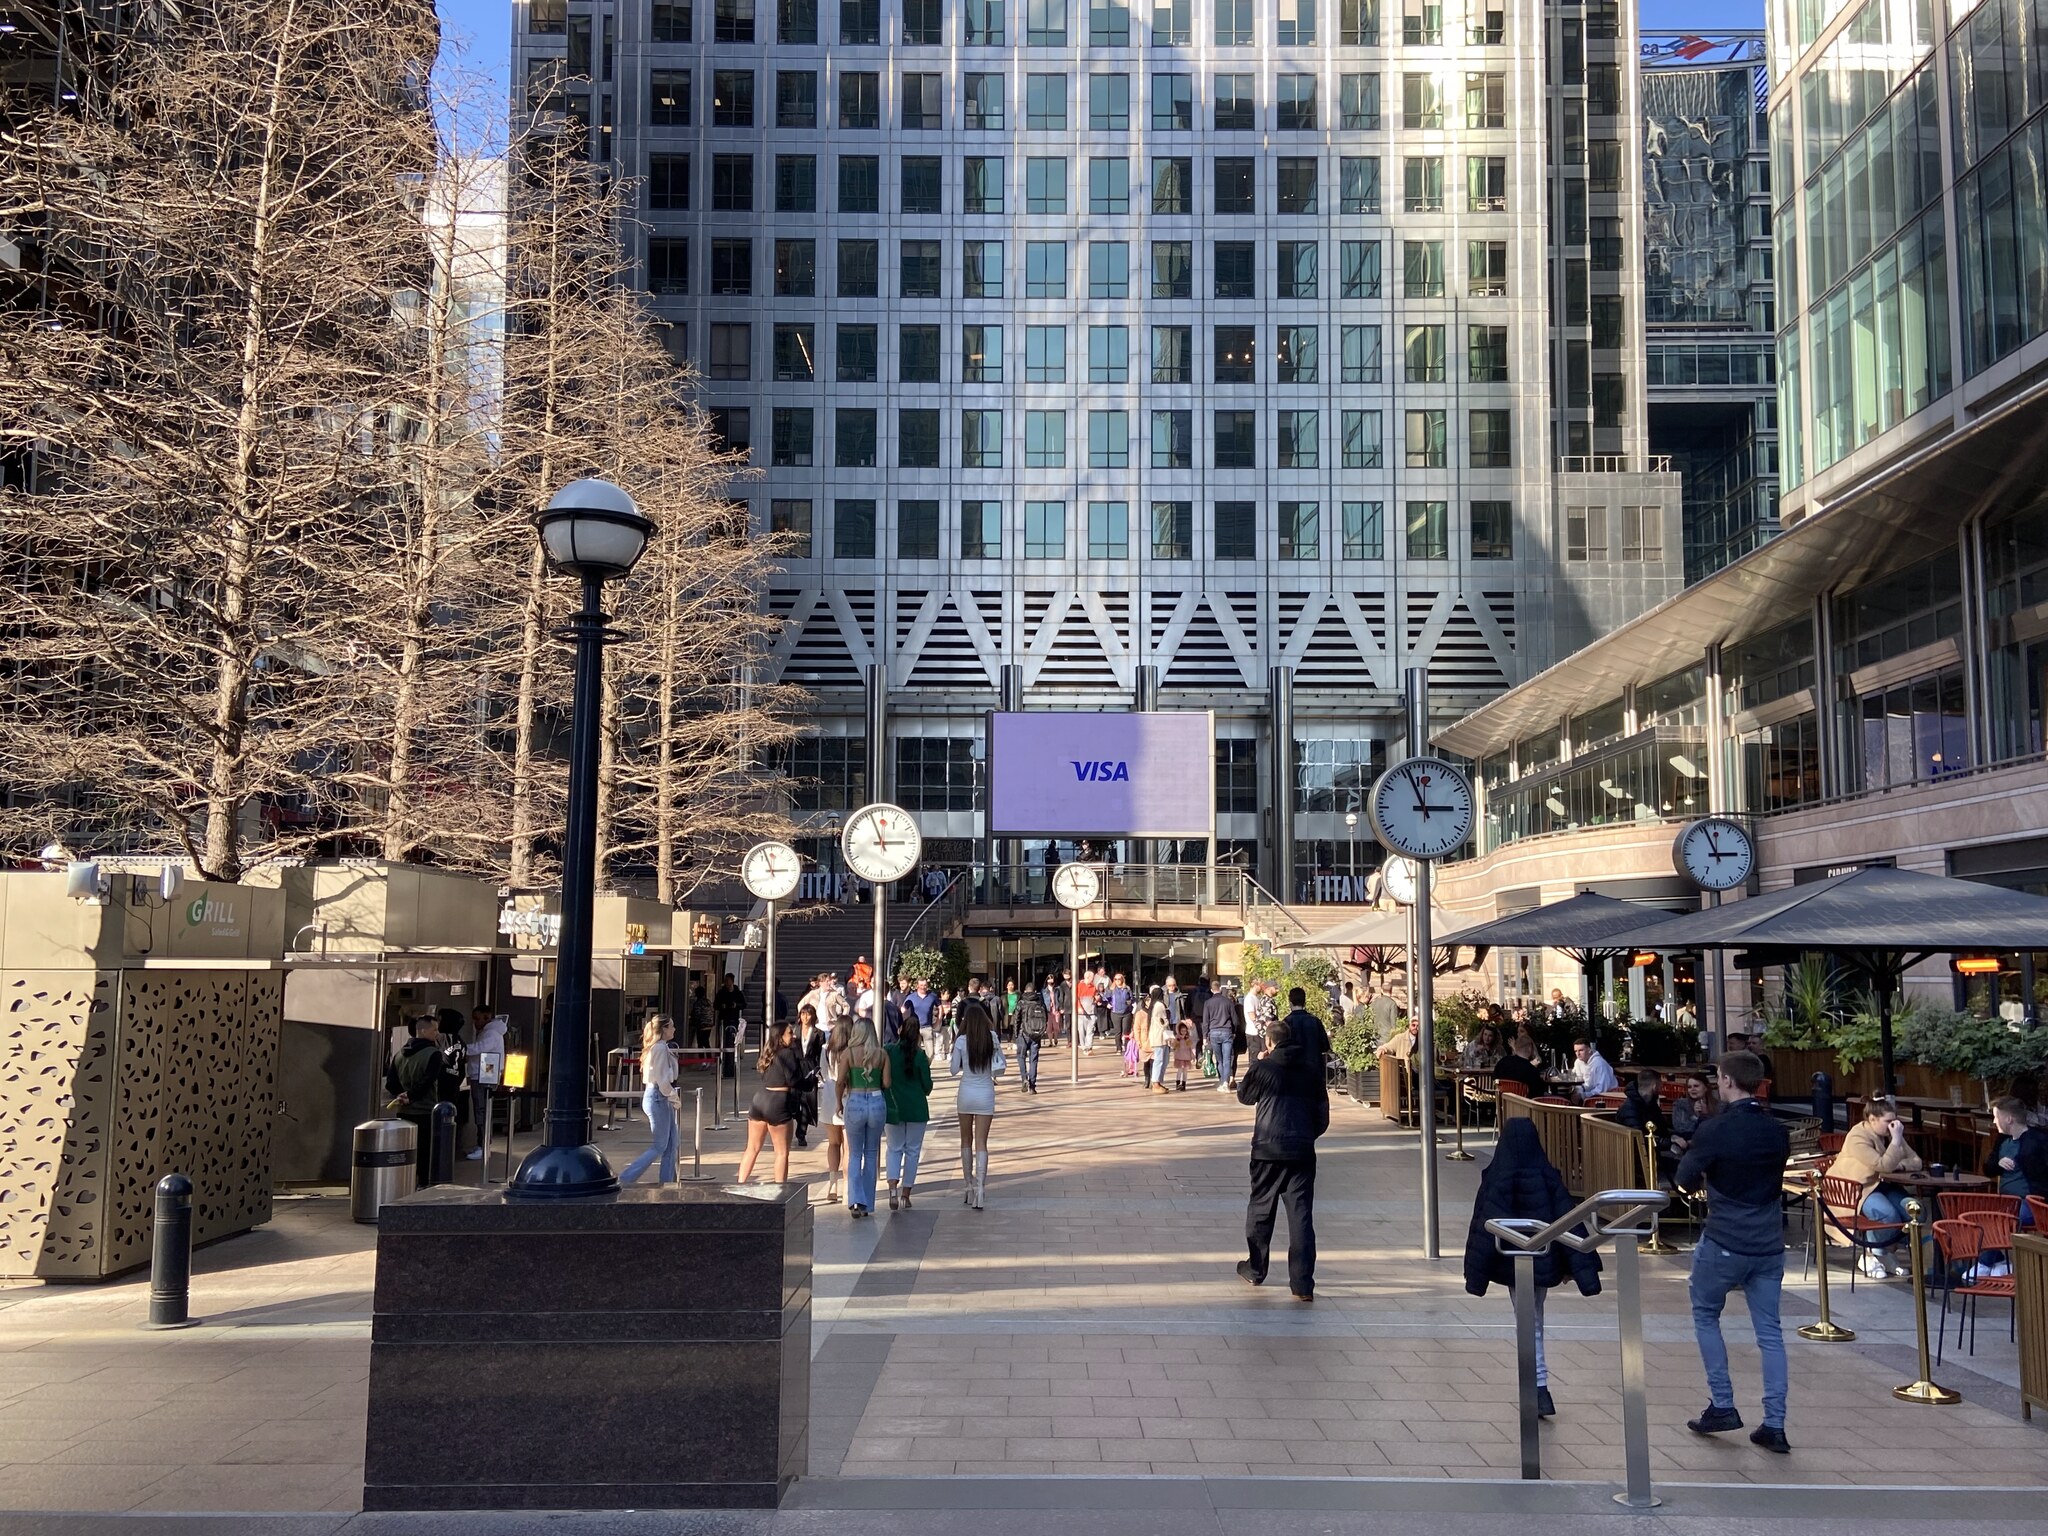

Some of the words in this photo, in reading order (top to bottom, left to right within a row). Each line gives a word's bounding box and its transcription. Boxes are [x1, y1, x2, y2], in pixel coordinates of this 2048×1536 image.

[1069, 761, 1129, 781] VISA
[192, 900, 235, 924] GRILL
[1107, 929, 1132, 937] PLACE
